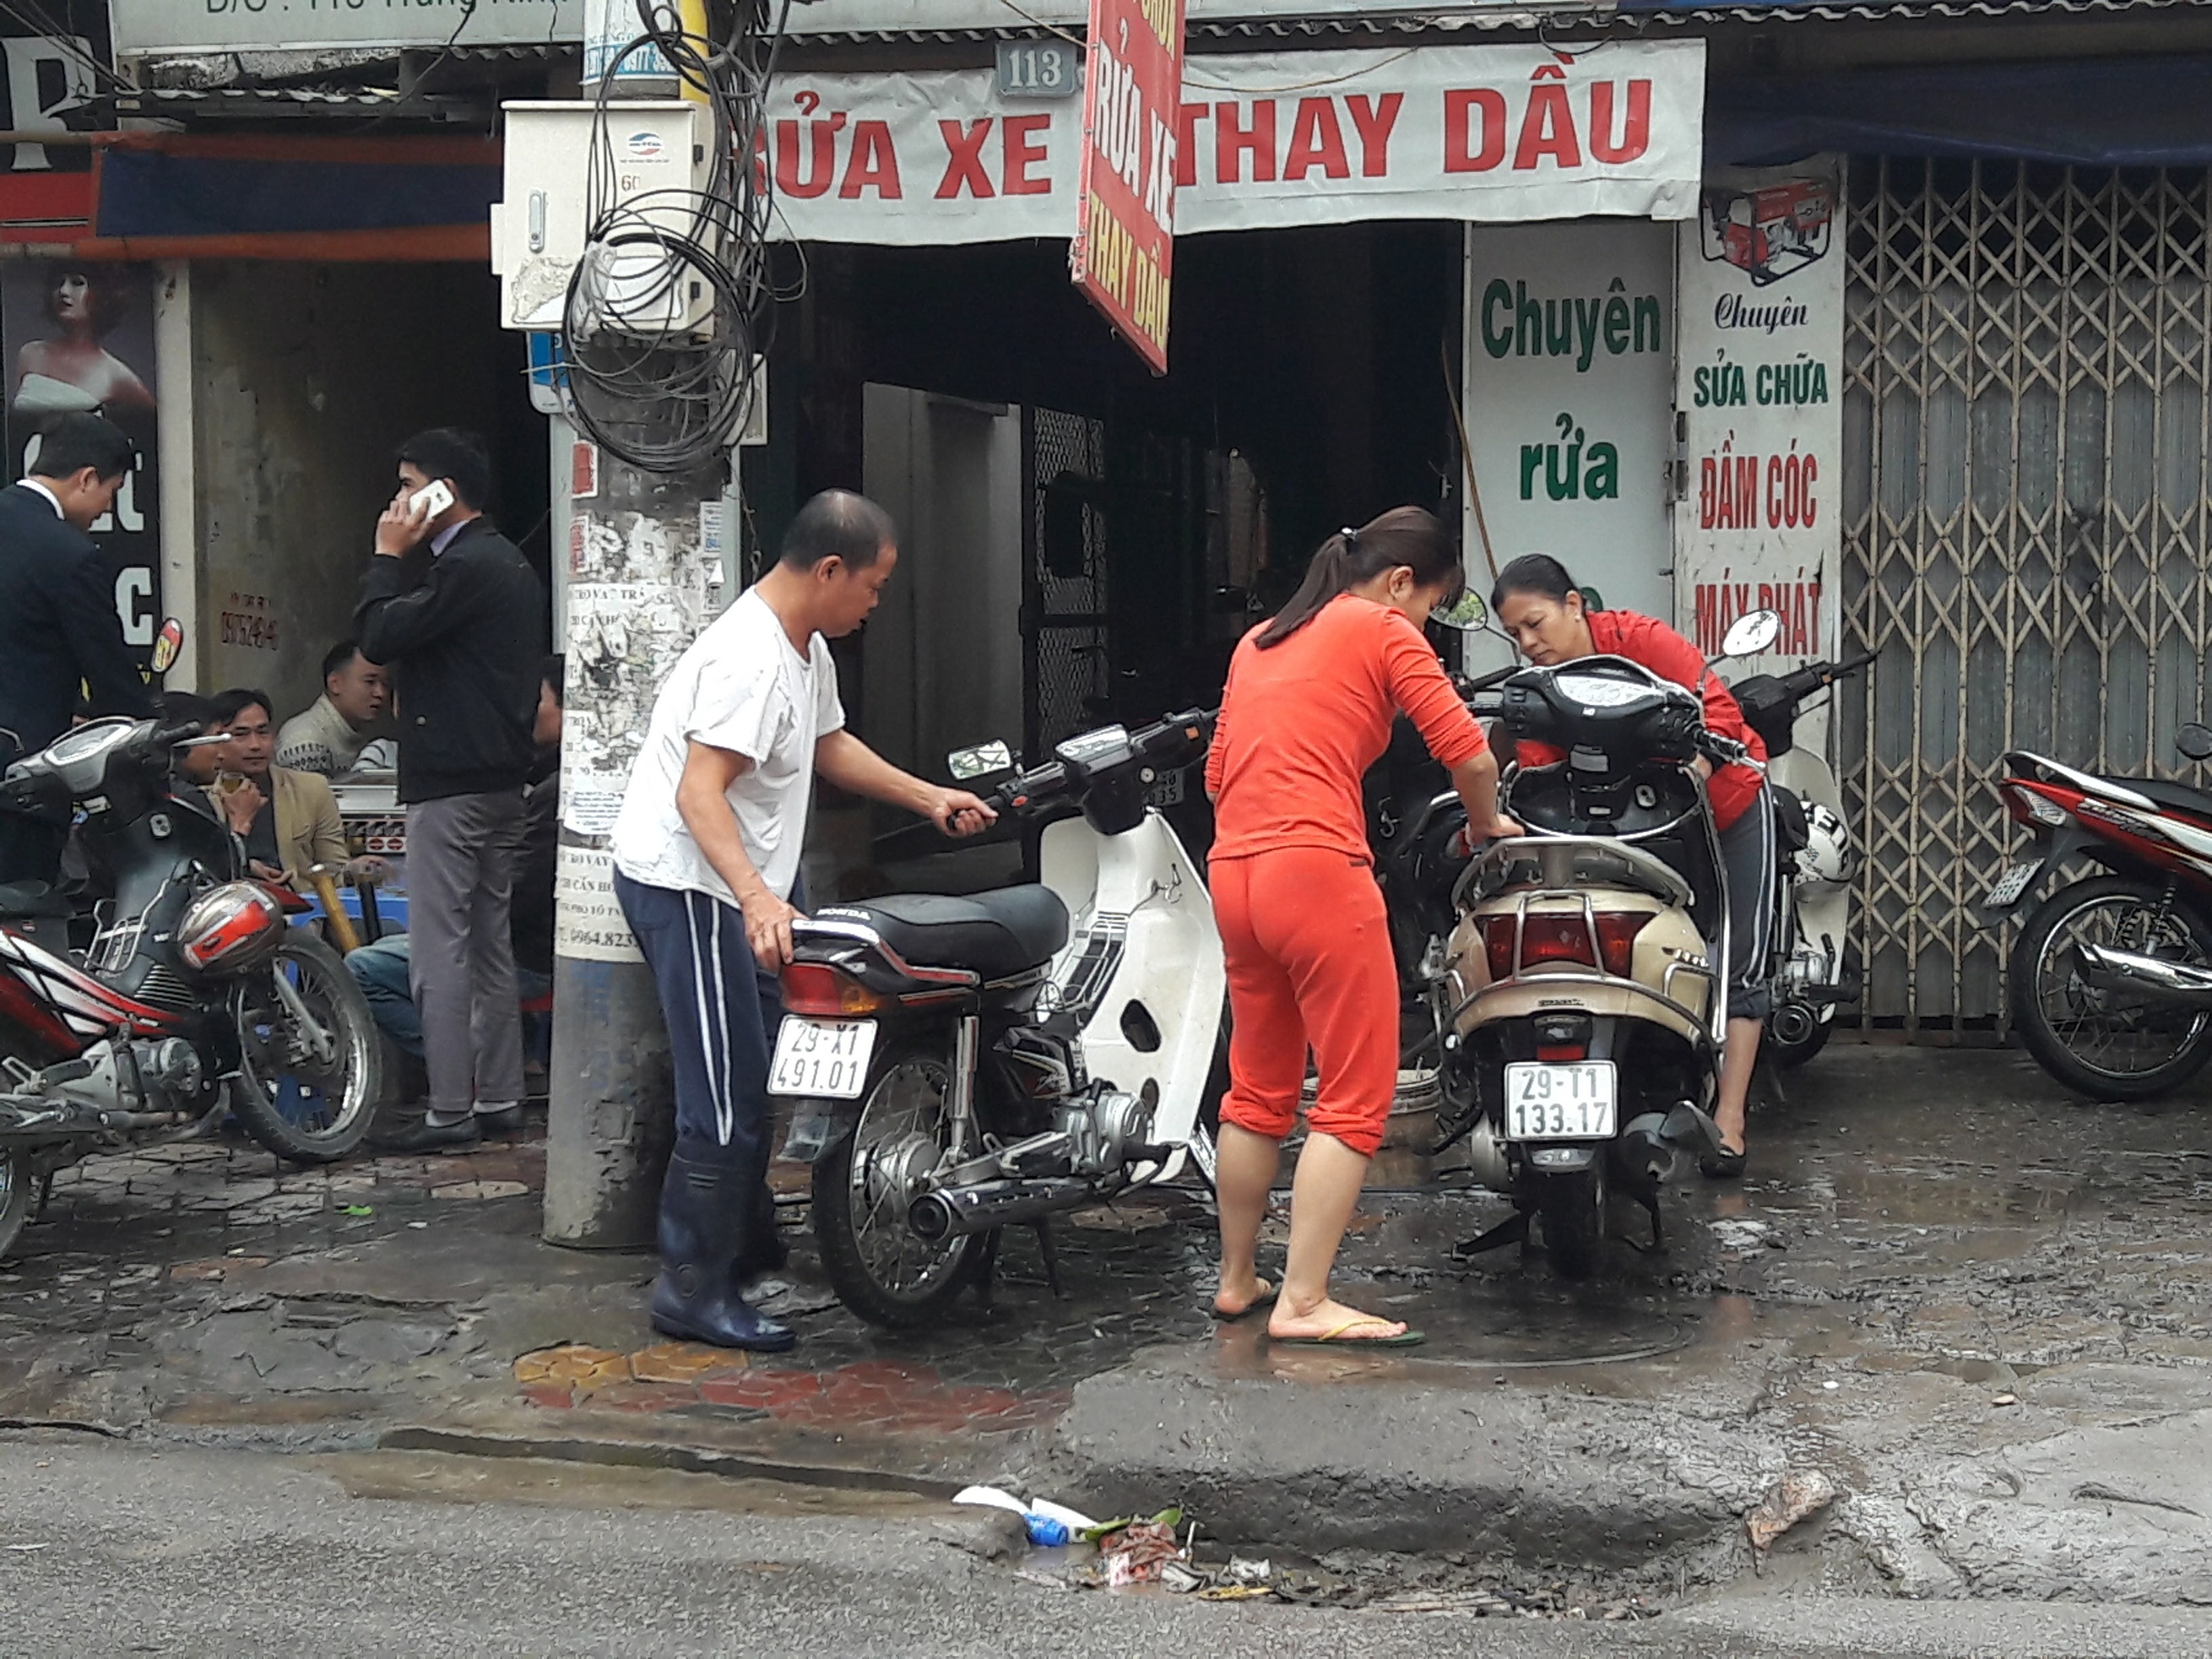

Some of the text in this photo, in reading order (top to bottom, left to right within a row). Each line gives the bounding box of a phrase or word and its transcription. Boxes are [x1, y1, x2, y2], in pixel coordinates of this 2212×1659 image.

[1008, 49, 1062, 88] 113
[934, 113, 1051, 199] XE
[1176, 92, 1404, 186] THAY
[1443, 53, 1652, 173] DẦU
[1094, 17, 1142, 198] RỬA
[1145, 106, 1177, 237] XE
[1088, 190, 1134, 310] THAY
[1481, 277, 1660, 372] Chuyên
[1715, 293, 1809, 335] Chuyên
[1694, 348, 1828, 407] SỬA CHỮA
[1519, 413, 1619, 501] rửa
[1700, 429, 1817, 529] ĐẦM CÓC
[792, 1021, 859, 1055] 29-X1
[777, 1058, 858, 1091] 491.01
[1521, 1068, 1597, 1100] 29-T1
[1515, 1102, 1608, 1135] 133.17
